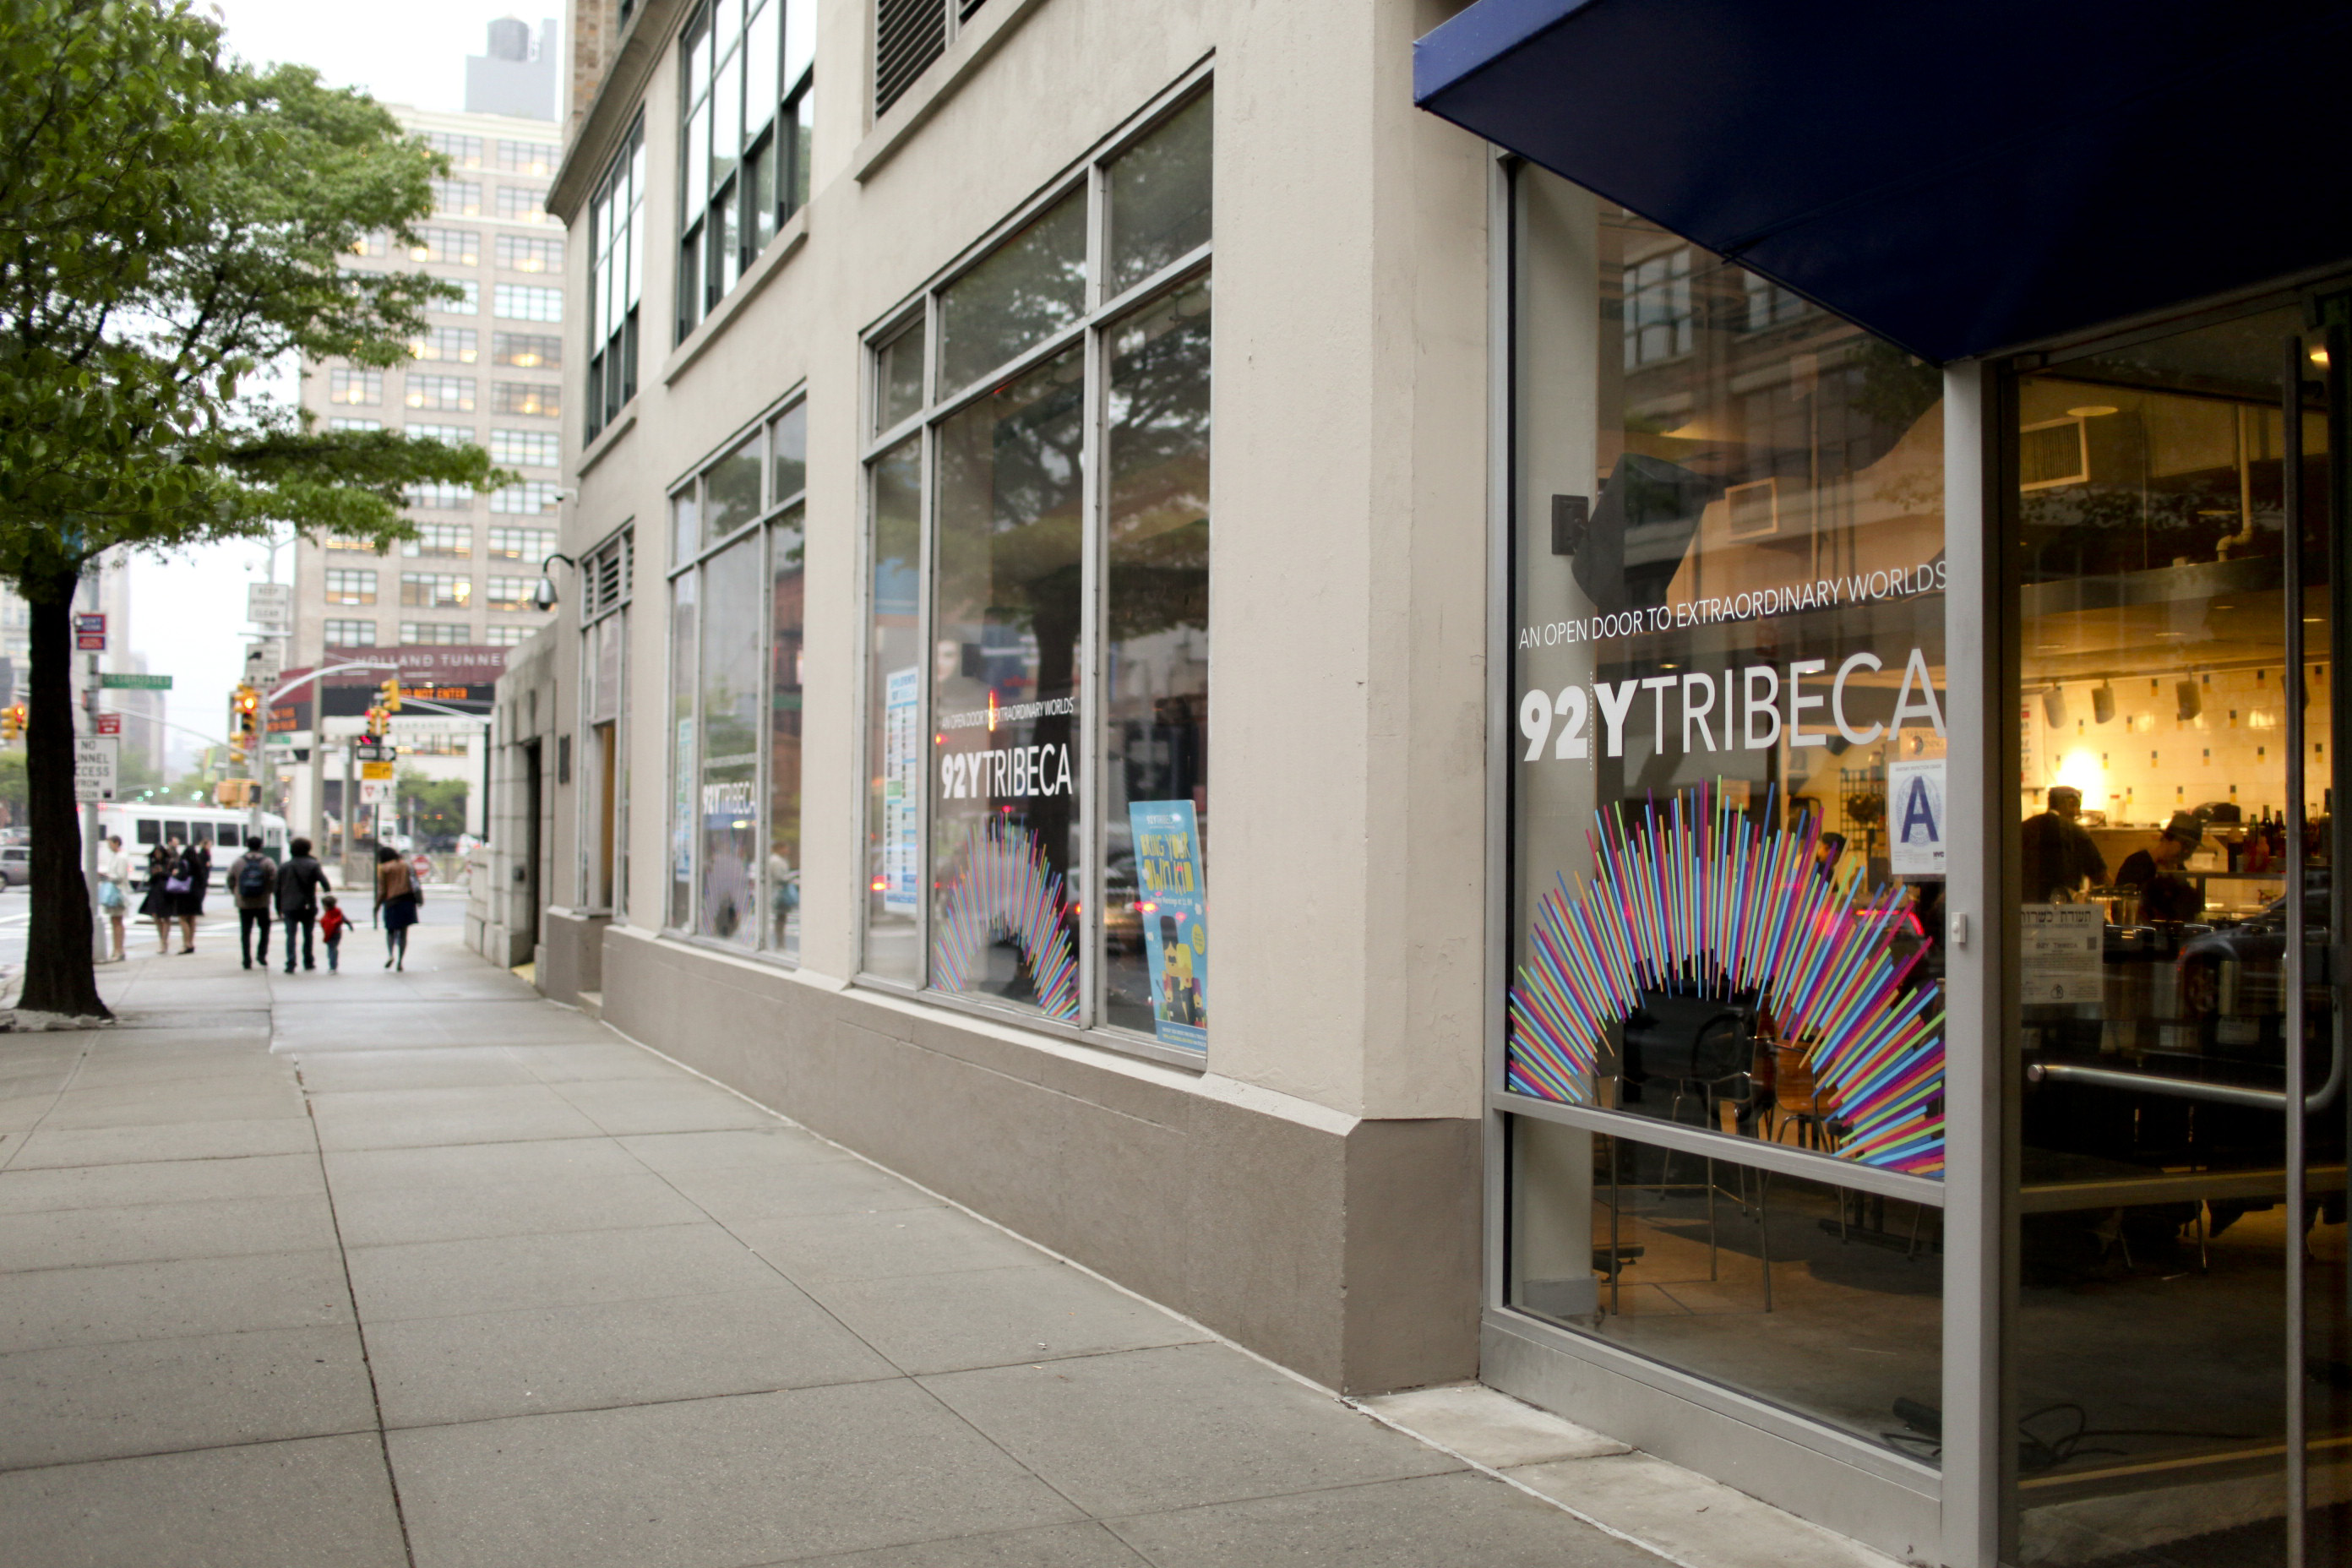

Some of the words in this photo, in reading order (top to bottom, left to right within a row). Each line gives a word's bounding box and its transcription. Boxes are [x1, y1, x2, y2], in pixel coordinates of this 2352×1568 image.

[1519, 625, 1540, 649] AN
[1544, 618, 1587, 646] OPEN
[1592, 611, 1643, 640] DOOR
[1647, 607, 1671, 632] TO
[1677, 578, 1843, 628] EXTRAORDINARY
[1847, 560, 1946, 600] WORLDS
[994, 701, 1043, 723] EXTRAORDINARY
[1044, 697, 1074, 716] WORLDS
[1520, 649, 1946, 762] 92YTRIBECA
[81, 740, 95, 750] NO
[941, 743, 1073, 799] 92YTRIBECA
[1901, 776, 1940, 843] A
[1140, 834, 1165, 857] BRING
[1173, 859, 1195, 896] KID
